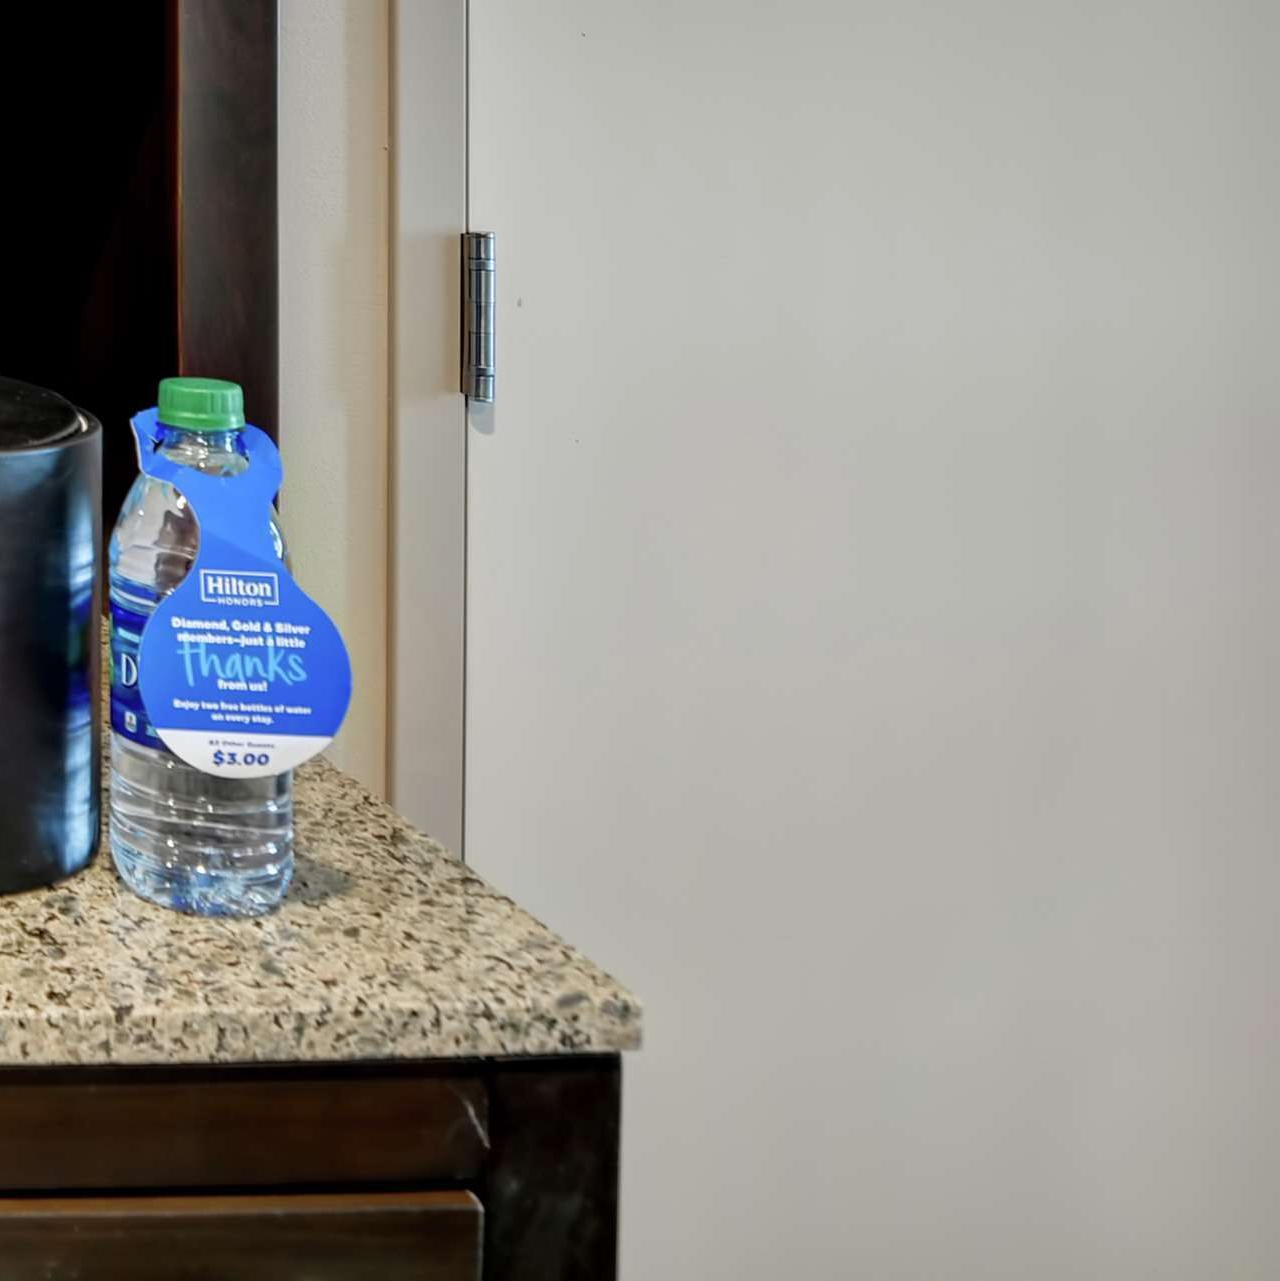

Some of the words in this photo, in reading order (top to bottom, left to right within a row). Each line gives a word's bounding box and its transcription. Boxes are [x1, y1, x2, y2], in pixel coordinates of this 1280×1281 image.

[207, 575, 272, 597] Hilton
[218, 597, 263, 607] HONORS
[171, 616, 230, 631] Diamond,
[232, 619, 260, 633] Gold
[263, 621, 273, 633] &
[275, 622, 311, 635] Silver
[276, 636, 306, 648] little
[217, 679, 248, 692] from
[249, 681, 268, 692] us!
[202, 701, 219, 711] two
[220, 702, 239, 712] free
[240, 703, 273, 714] bottles
[274, 704, 284, 714] of
[225, 714, 251, 724] every
[213, 750, 270, 767] $3.00
